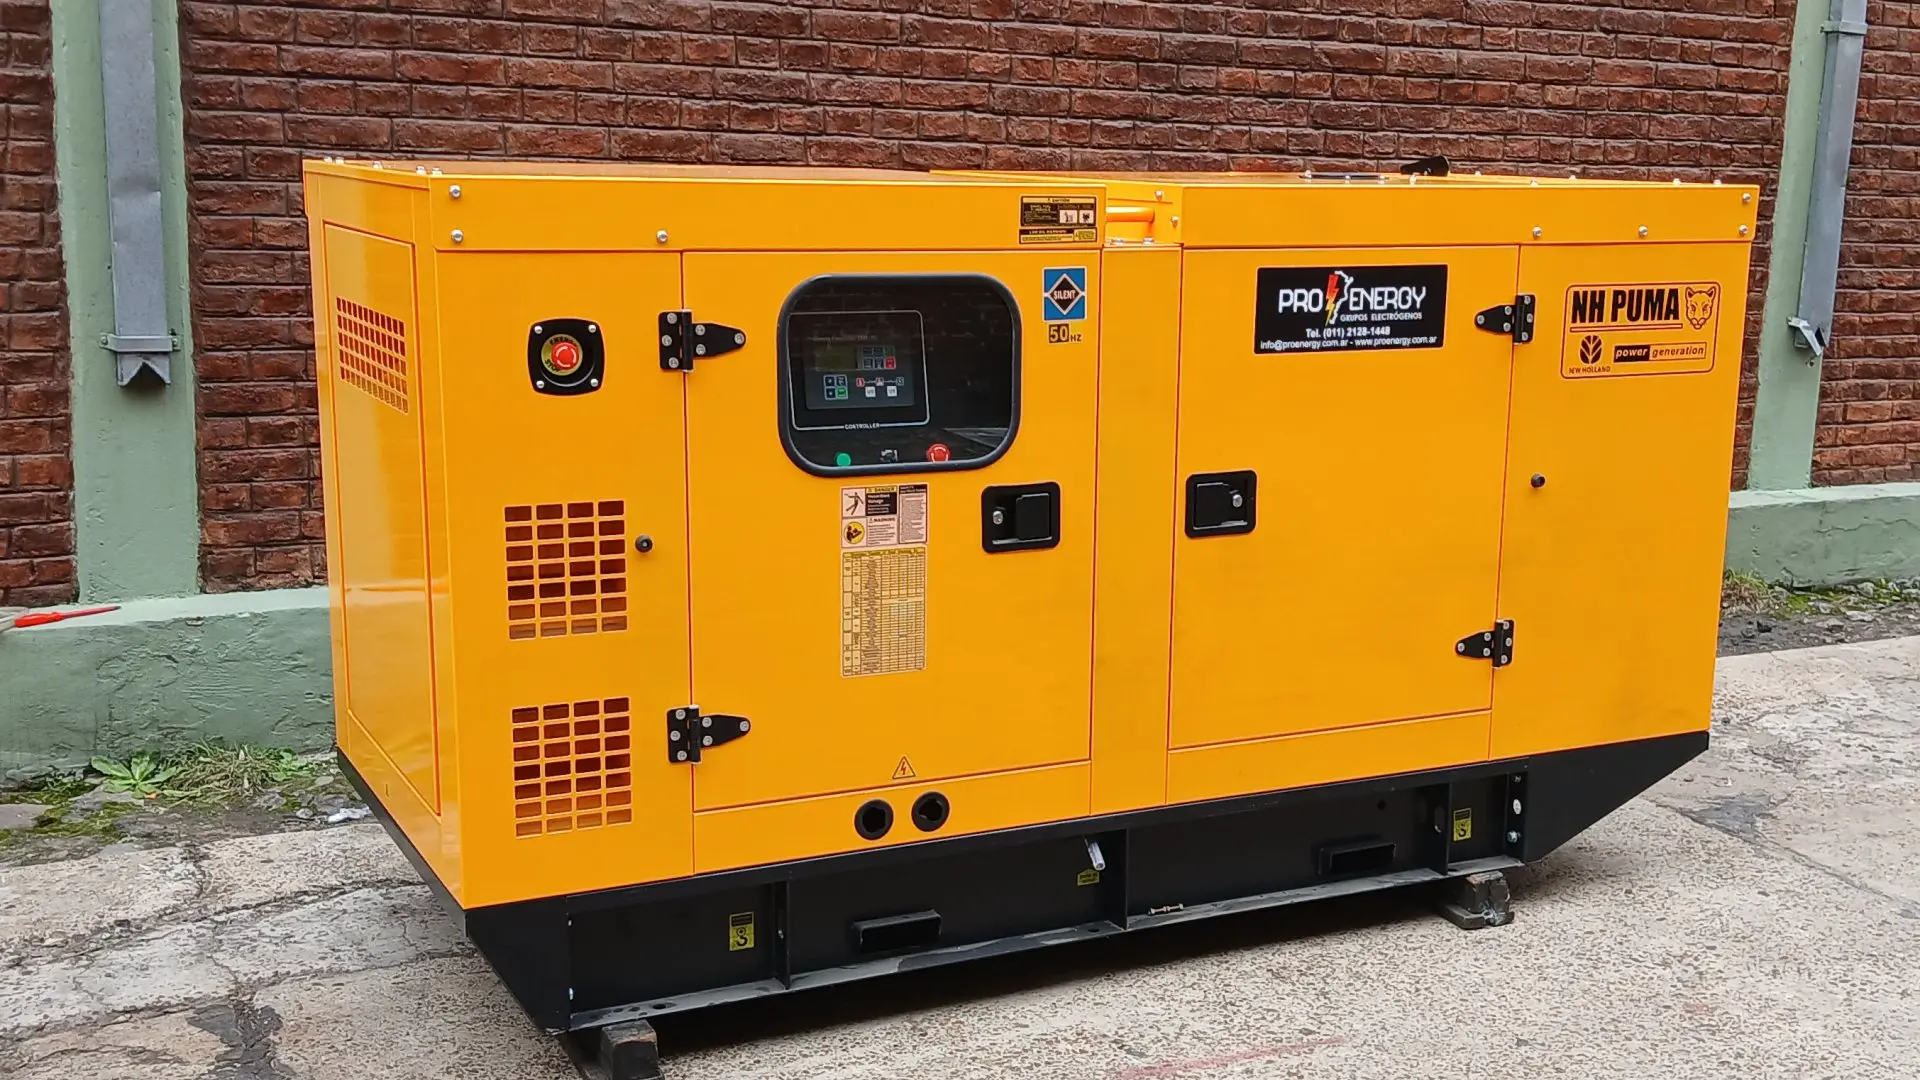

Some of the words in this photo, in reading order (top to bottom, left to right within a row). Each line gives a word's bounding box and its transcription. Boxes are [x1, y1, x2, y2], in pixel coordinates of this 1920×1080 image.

[1053, 290, 1076, 300] SILENT
[1278, 288, 1323, 313] PRO
[1350, 286, 1426, 311] ENERGY
[1571, 290, 1606, 323] NH
[1611, 288, 1680, 322] PUMA
[1340, 313, 1368, 322] GRUPOS
[1371, 311, 1422, 321] ELECTRÓGENOS
[1306, 328, 1321, 338] Tel.
[1323, 327, 1345, 338] (011)
[1347, 326, 1391, 337] 2128-1448
[1260, 339, 1348, 350] info@proenergy.com.ar
[1355, 336, 1437, 347] www.proenergy.com.ar
[1615, 347, 1648, 358] power
[1652, 345, 1704, 358] generation
[1582, 365, 1611, 374] HOLLAND
[845, 422, 880, 430] CONTROLLER
